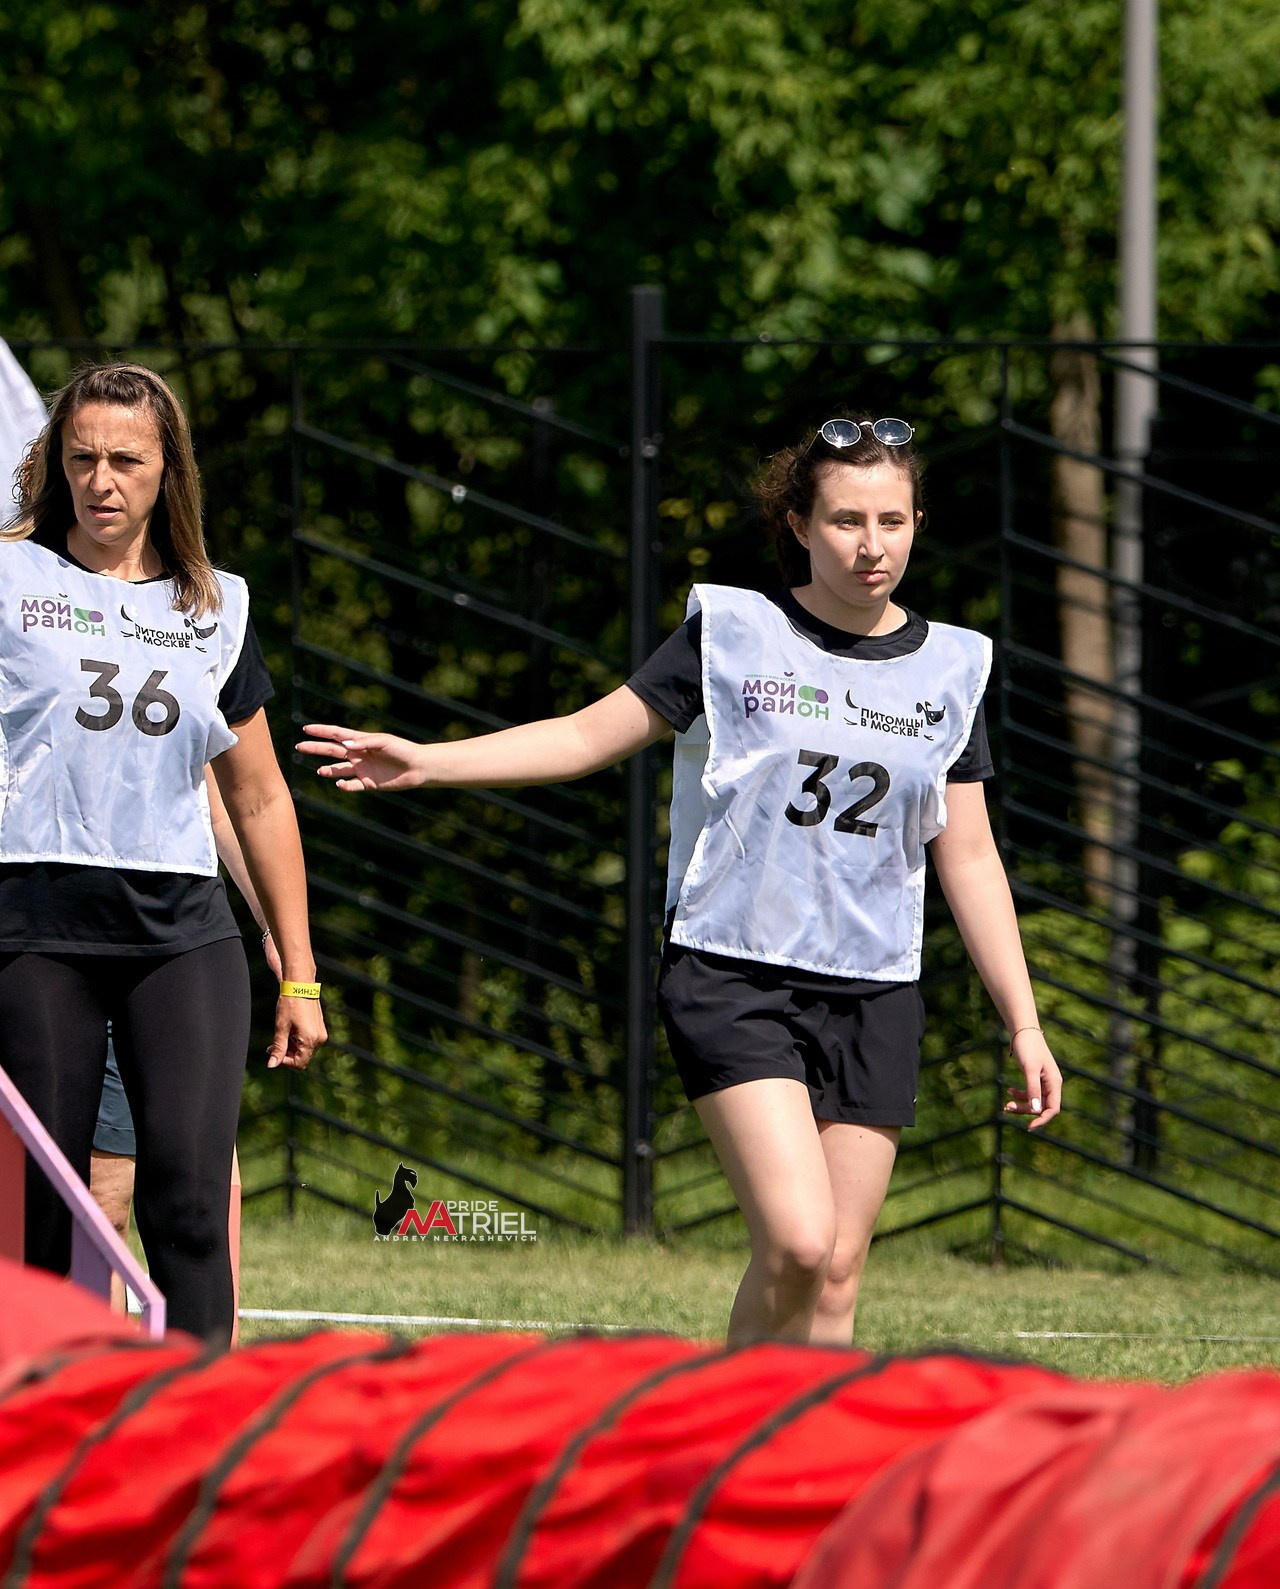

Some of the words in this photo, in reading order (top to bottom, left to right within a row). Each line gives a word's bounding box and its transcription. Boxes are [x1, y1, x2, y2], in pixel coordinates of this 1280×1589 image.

[134, 622, 193, 642] ПИТОМЦЫ
[143, 636, 190, 649] МОСКВЕ
[75, 658, 180, 736] 36
[861, 707, 923, 728] ПИТОМЦЫ
[861, 717, 867, 727] В
[871, 721, 919, 738] МОСКВЕ
[784, 749, 891, 838] 32
